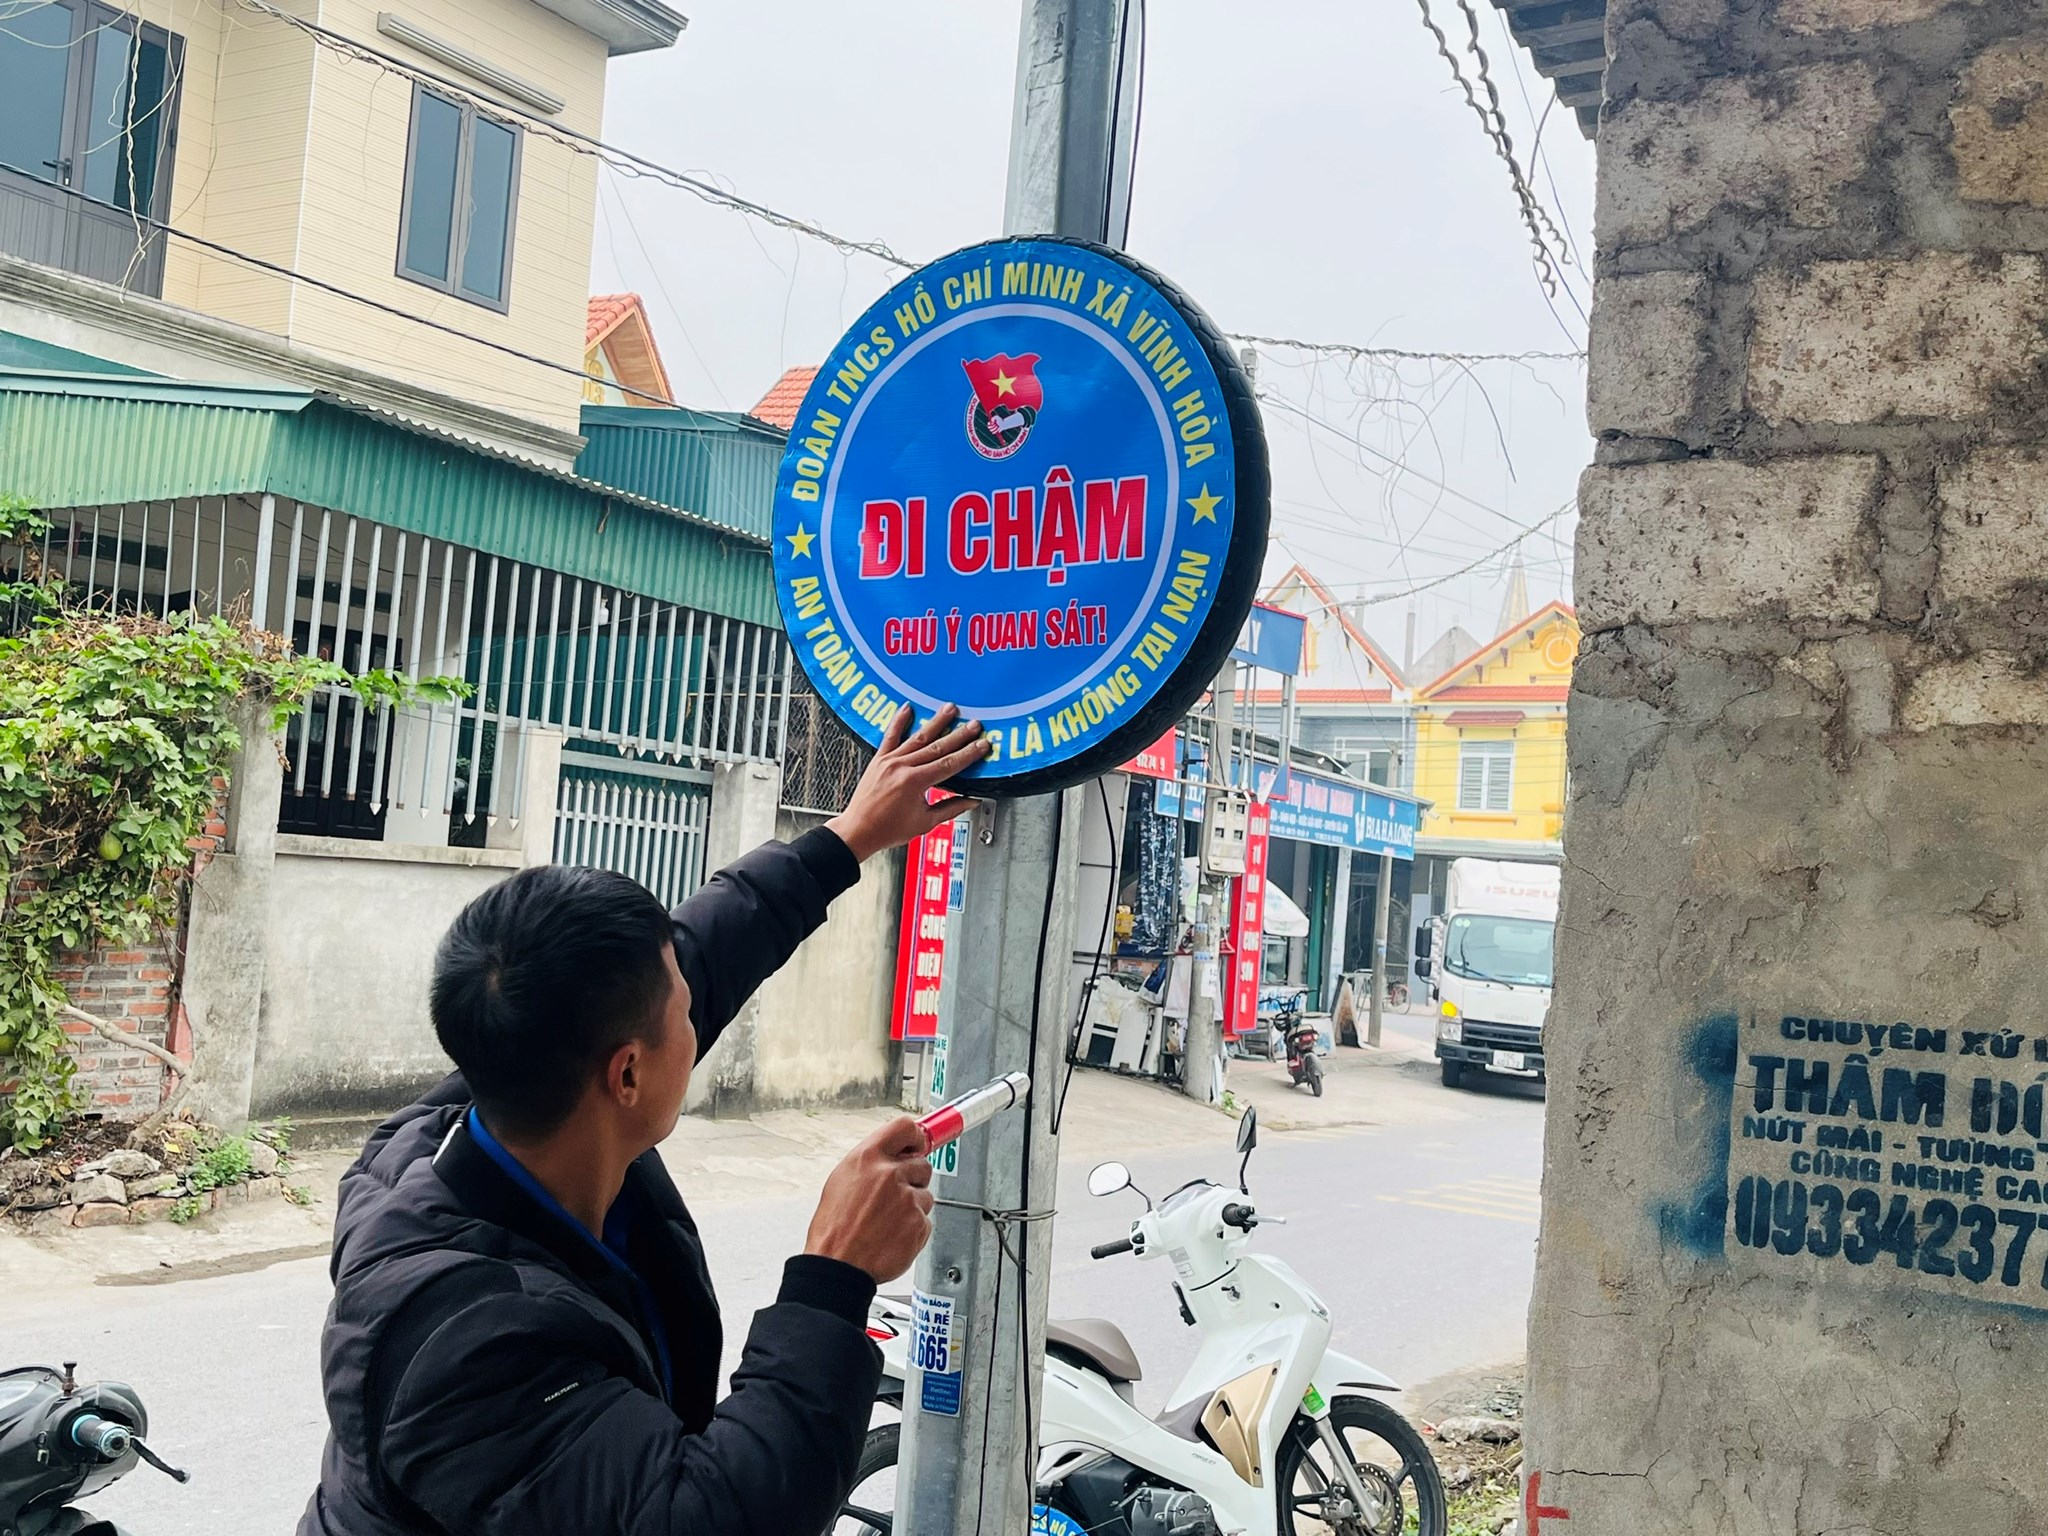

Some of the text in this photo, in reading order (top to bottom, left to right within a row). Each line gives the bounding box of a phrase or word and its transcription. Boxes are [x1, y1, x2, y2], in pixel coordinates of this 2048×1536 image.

[791, 258, 1216, 503] ĐOÀN TNCS HỒ CHÍ MINH XÃ VĨNH HÒA
[858, 465, 1149, 587] ĐI CHẬM
[790, 575, 899, 733] AN TOÀN GIA
[884, 598, 1106, 657] CHÚ Ý QUAN SÁT!
[1010, 718, 1045, 760] LÀ
[1048, 664, 1143, 748] KHÔNG
[1131, 622, 1179, 672] TAI
[1160, 549, 1211, 624] NẠN
[1780, 1016, 1947, 1053] CHUYÊN
[1791, 1149, 1881, 1183] CÔNG
